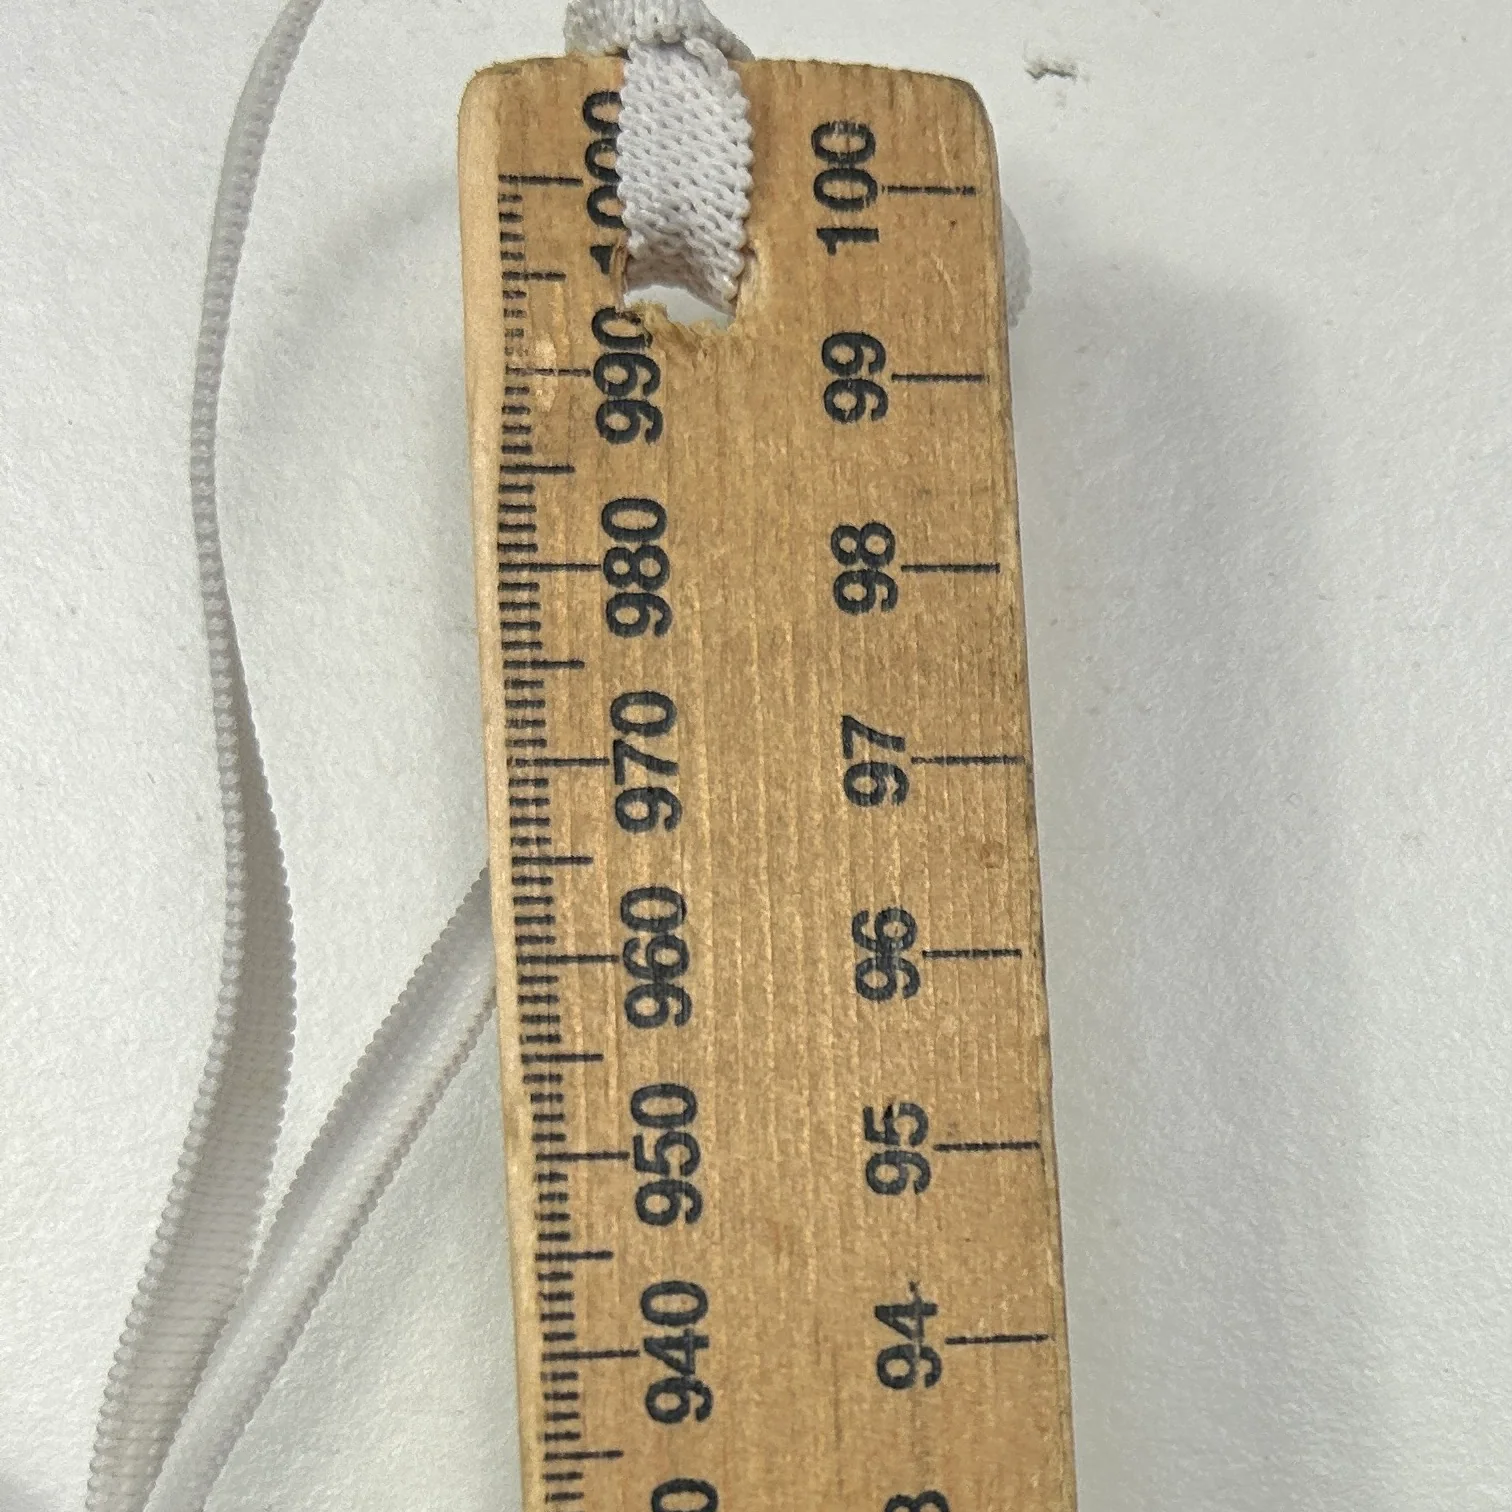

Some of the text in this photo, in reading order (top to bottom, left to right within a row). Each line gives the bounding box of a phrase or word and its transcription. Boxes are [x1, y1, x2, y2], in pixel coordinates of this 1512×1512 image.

[811, 120, 880, 255] 100
[591, 305, 663, 444] 990
[821, 330, 889, 425] 99
[601, 497, 672, 638] 980
[831, 520, 899, 616] 98
[609, 689, 683, 834] 970
[841, 714, 909, 807] 97
[620, 886, 691, 1028] 960
[852, 906, 920, 1004] 96
[630, 1082, 703, 1227] 950
[862, 1102, 931, 1196] 95
[640, 1280, 713, 1425] 940
[874, 1293, 942, 1391] 94
